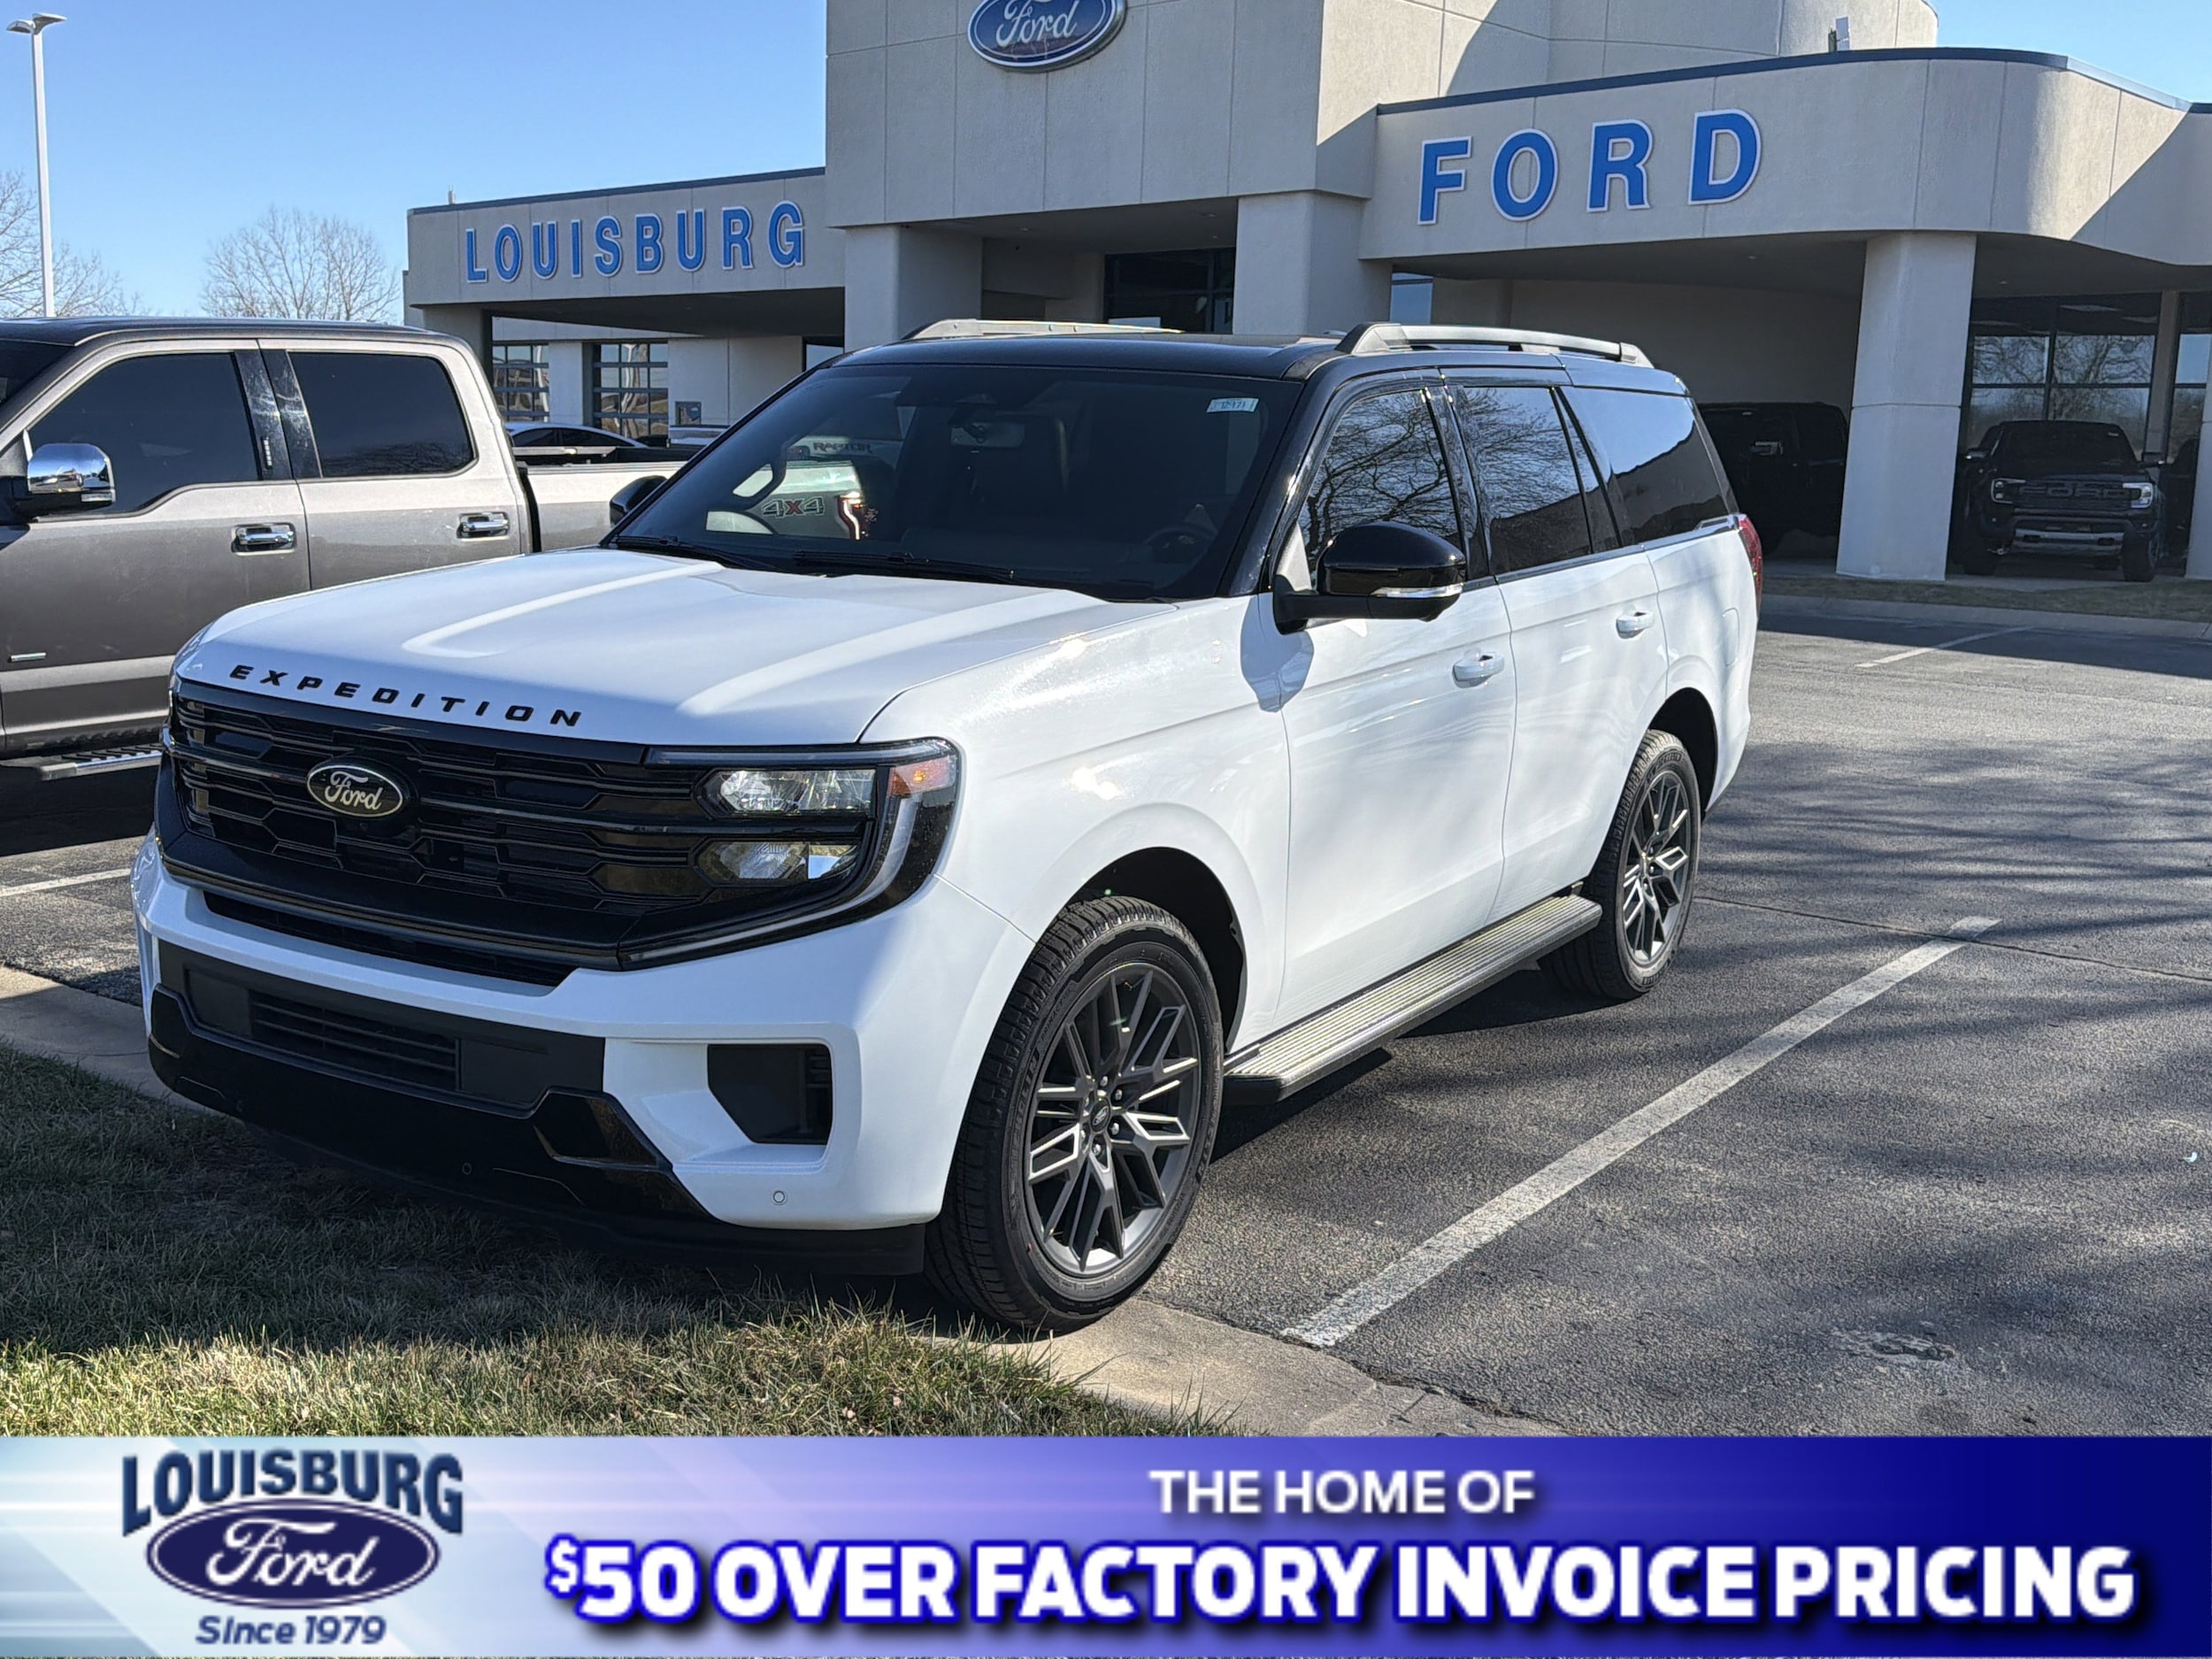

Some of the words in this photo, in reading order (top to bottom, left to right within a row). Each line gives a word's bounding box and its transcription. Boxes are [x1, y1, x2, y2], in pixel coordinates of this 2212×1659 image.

[995, 0, 1078, 48] Ford
[1417, 109, 1762, 226] FORD
[465, 200, 804, 283] LOUISBURG
[2018, 484, 2130, 501] FORD
[229, 664, 582, 727] EXPEDITION
[325, 771, 384, 810] Ford
